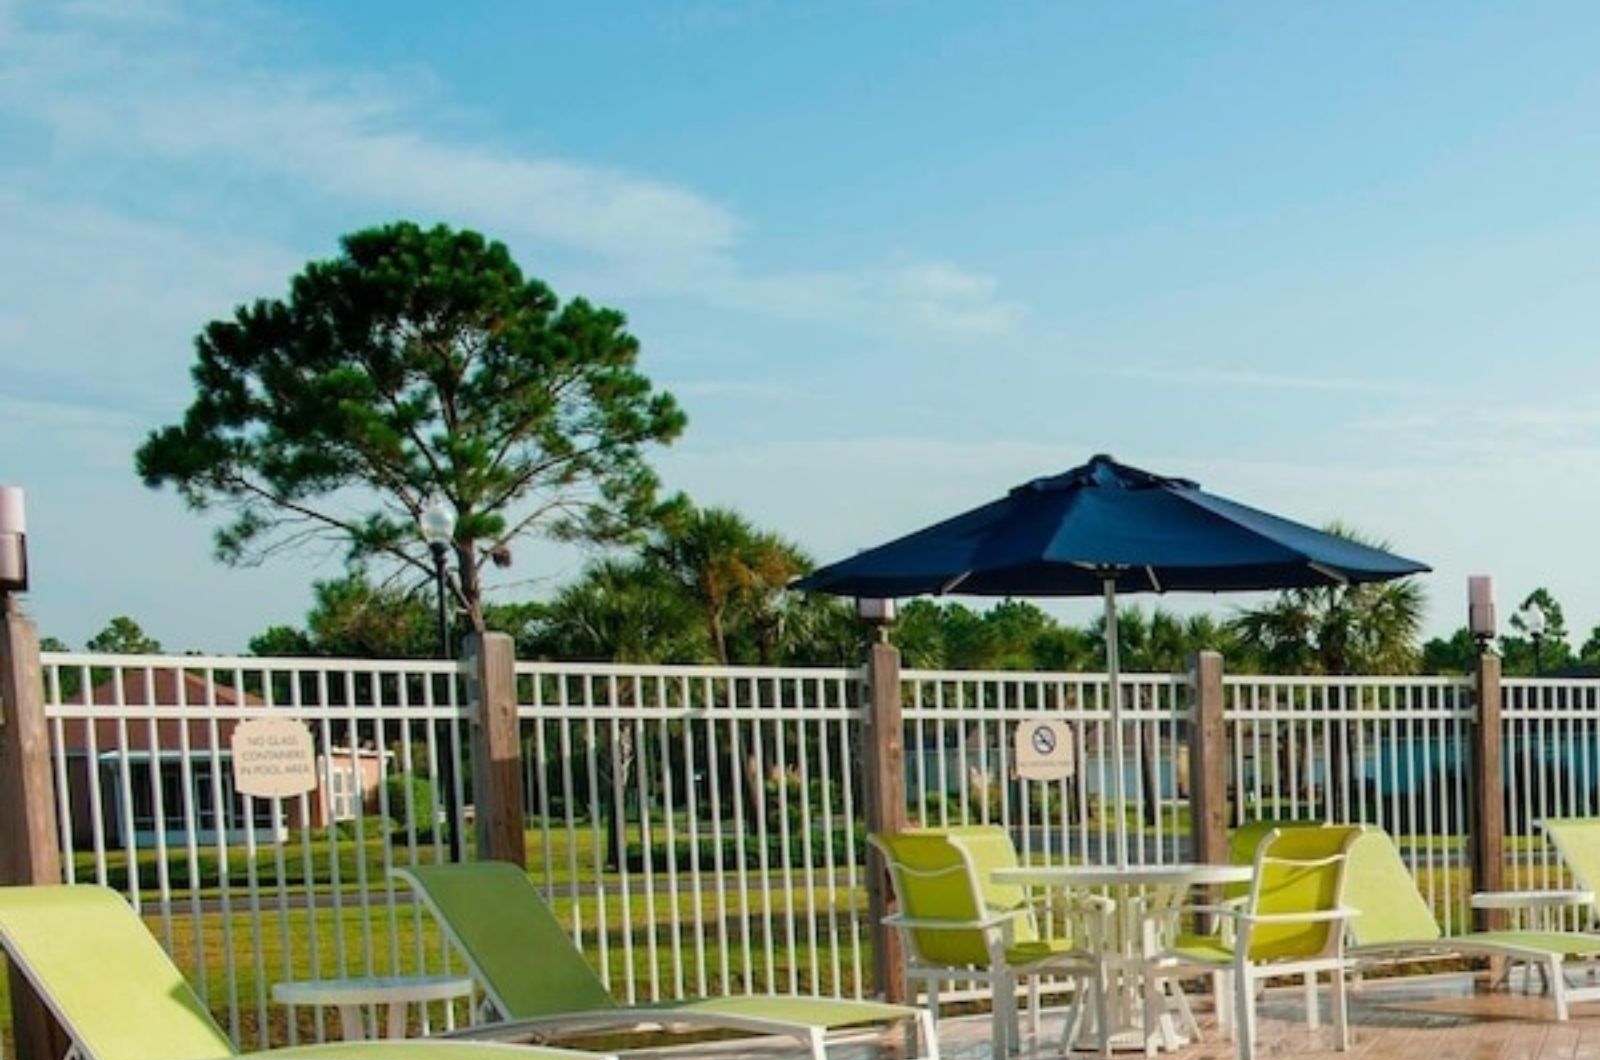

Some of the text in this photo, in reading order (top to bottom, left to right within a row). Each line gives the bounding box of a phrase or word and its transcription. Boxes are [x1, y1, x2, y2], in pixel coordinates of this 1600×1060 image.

[247, 734, 299, 747] NO GLASS
[241, 749, 305, 761] CONTAINERS
[240, 764, 310, 775] IN POOL AREA
